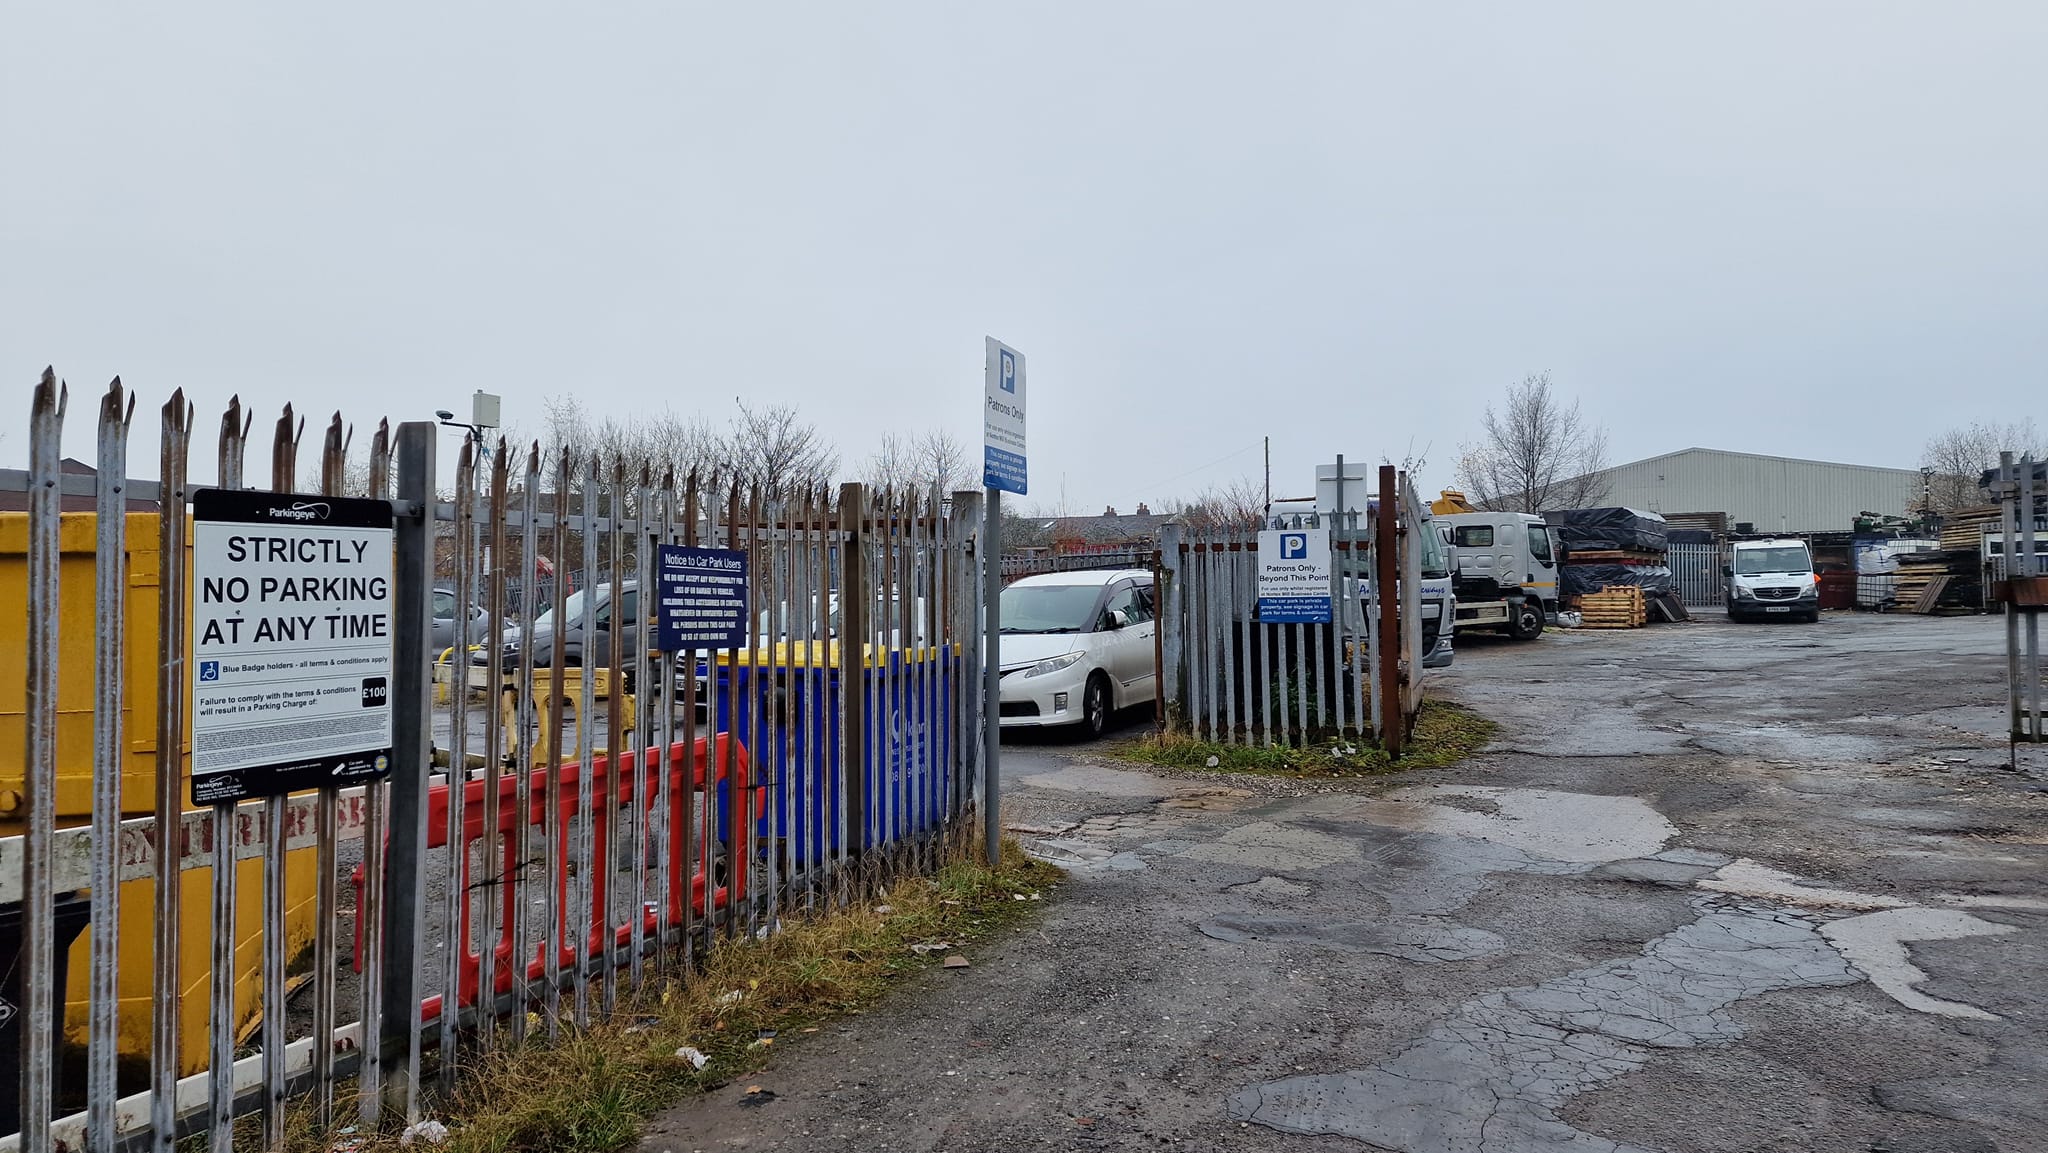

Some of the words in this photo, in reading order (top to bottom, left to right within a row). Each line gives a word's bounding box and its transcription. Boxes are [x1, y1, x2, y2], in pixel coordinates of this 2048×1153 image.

[988, 396, 1010, 416] Patrons
[1012, 406, 1024, 424] Only
[269, 507, 316, 520] Parkingeye
[228, 536, 368, 563] STRICTLY
[665, 553, 686, 565] Notice
[688, 556, 695, 566] to
[696, 556, 708, 567] Car
[709, 556, 723, 568] Park
[724, 558, 742, 569] Users
[1298, 564, 1316, 573] Only
[1260, 574, 1288, 583] Beyond
[204, 576, 250, 603] NO
[260, 577, 387, 602] PARKING
[201, 618, 244, 645] AT
[253, 616, 316, 642] ANY
[324, 614, 387, 639] TIME
[242, 664, 265, 672] Badge
[267, 662, 293, 670] holders
[336, 657, 370, 665] conditions
[371, 656, 388, 664] apply
[200, 698, 226, 706] Failure
[237, 694, 264, 703] comply
[266, 692, 280, 700] with
[323, 686, 356, 695] conditions
[362, 687, 386, 698] £100
[200, 708, 213, 716] will
[215, 706, 236, 714] result
[254, 702, 281, 711] Parking
[282, 699, 307, 708] Charge
